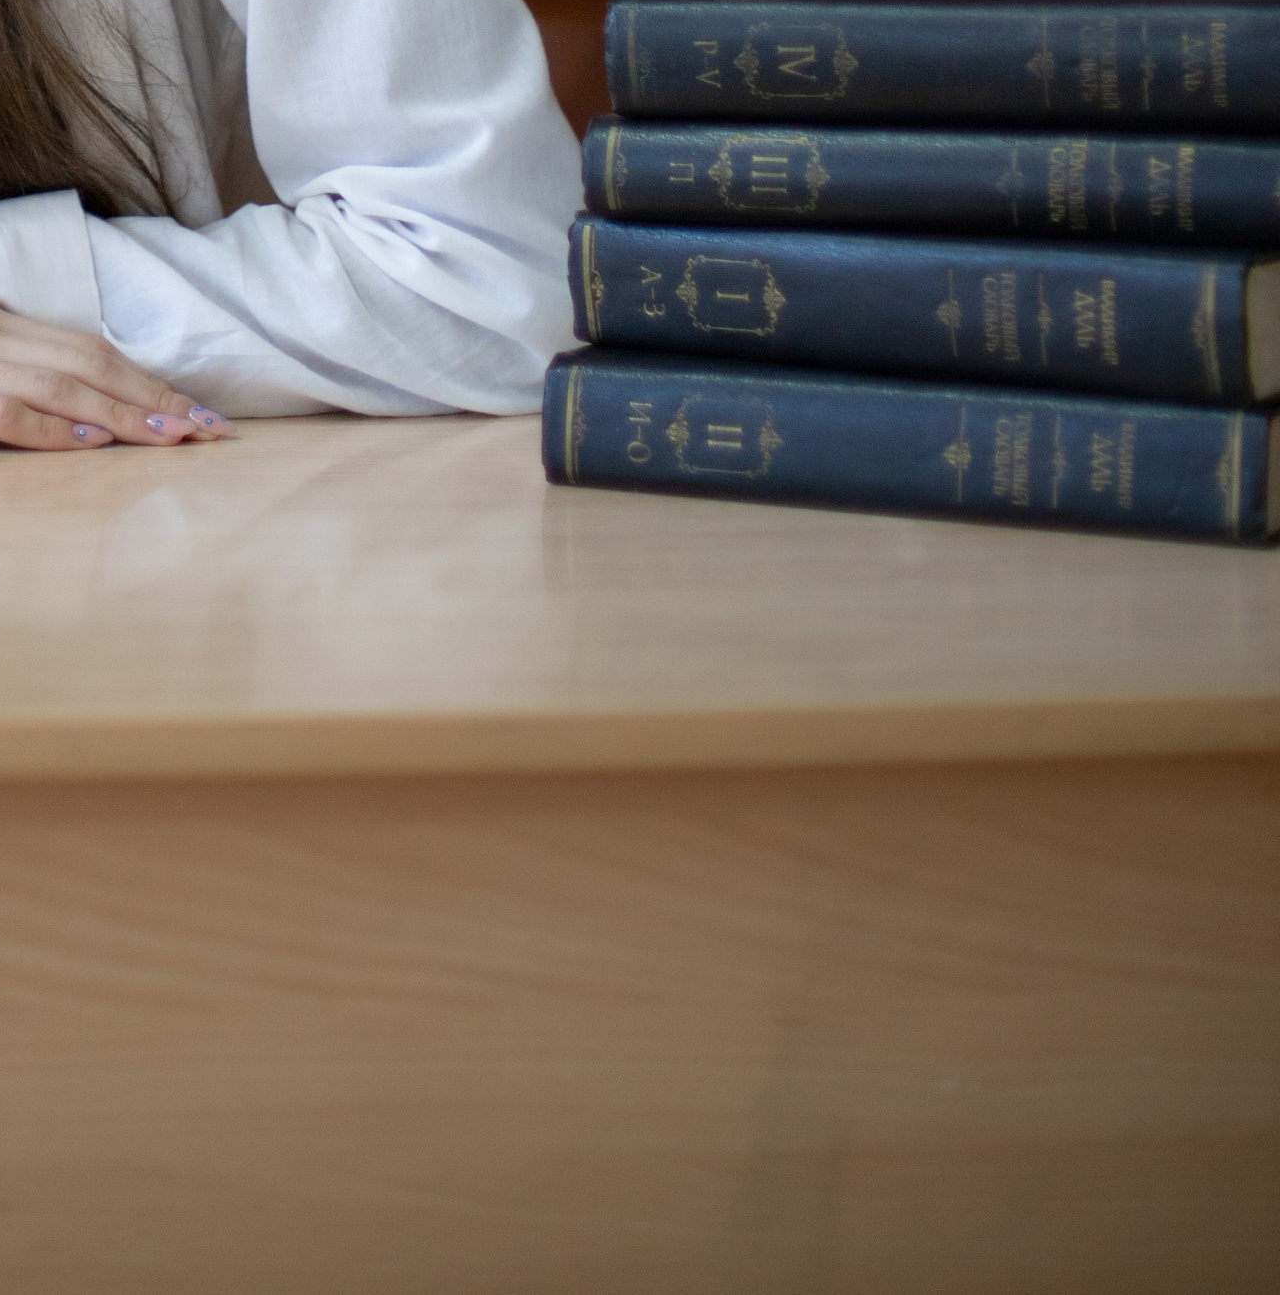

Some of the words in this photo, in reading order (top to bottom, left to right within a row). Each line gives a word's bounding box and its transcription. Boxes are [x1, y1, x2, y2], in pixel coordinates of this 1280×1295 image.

[777, 44, 818, 82] IV
[669, 162, 694, 182] П
[750, 155, 788, 194] III
[1148, 158, 1171, 216] ДАЛЬ
[716, 290, 749, 302] I
[1074, 289, 1096, 348] ДАЛЬ
[707, 424, 742, 449] II
[1090, 432, 1114, 492] ДАЛЬ
